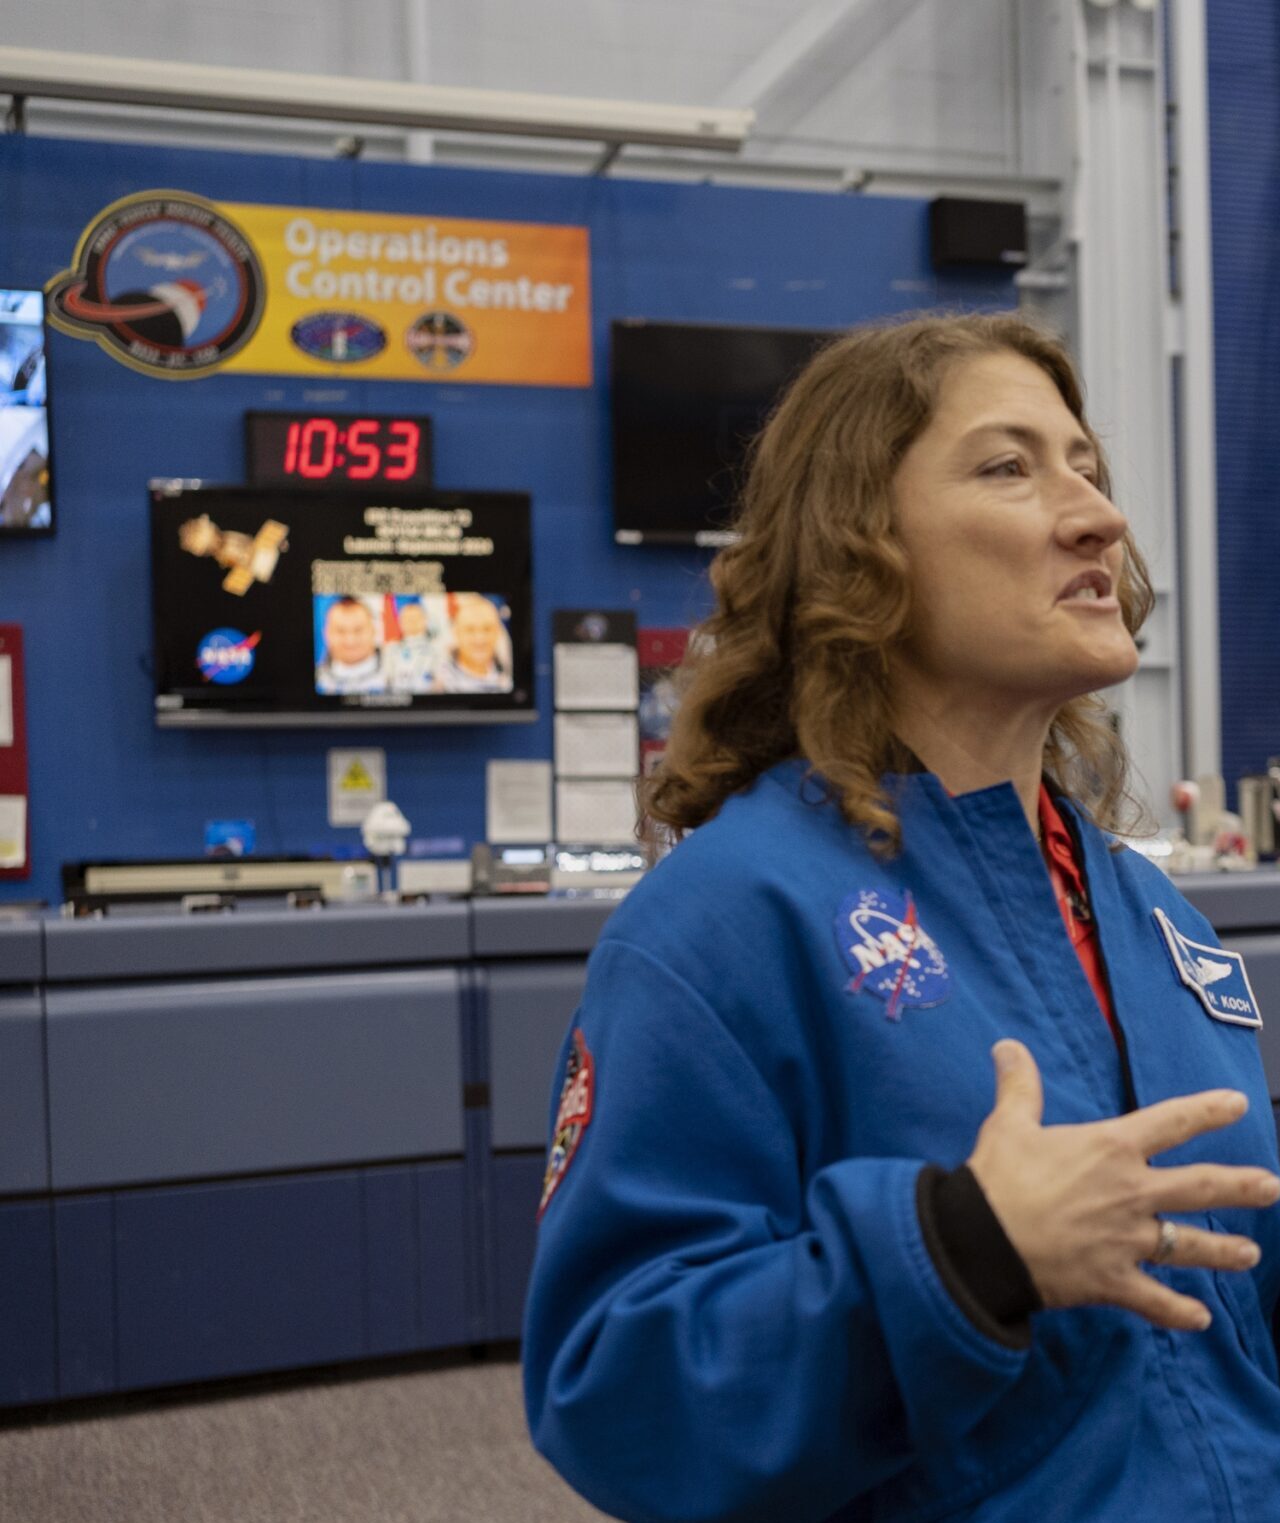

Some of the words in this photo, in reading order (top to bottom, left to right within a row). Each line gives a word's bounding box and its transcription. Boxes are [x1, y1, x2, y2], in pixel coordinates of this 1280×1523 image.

[284, 216, 510, 268] Operations
[285, 260, 437, 304] Control
[443, 269, 573, 313] Center
[283, 418, 420, 480] 10:53
[850, 922, 940, 974] NASA
[1220, 994, 1252, 1014] KOCH
